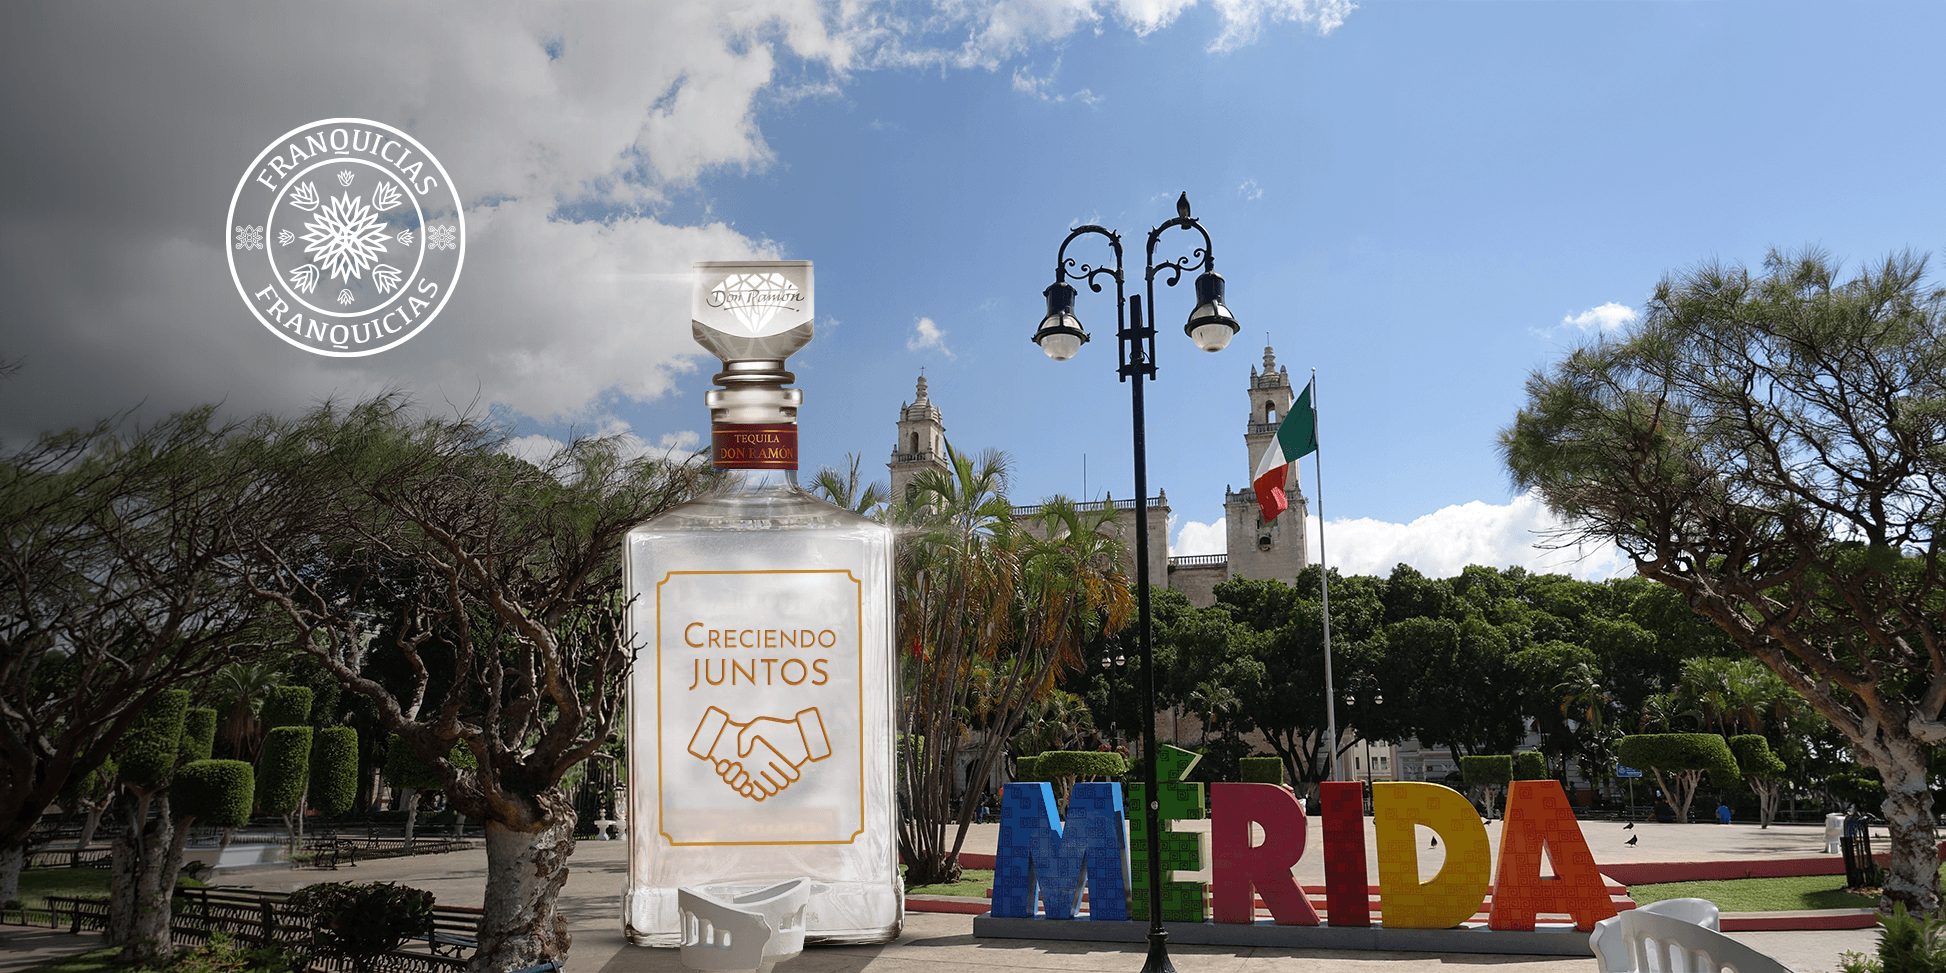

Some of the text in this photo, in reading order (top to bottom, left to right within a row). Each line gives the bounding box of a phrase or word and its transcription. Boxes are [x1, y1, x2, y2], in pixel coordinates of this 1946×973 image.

[706, 284, 805, 310] Don Ramón
[720, 444, 793, 459] DON RAMÓN
[734, 434, 780, 445] TEQUILA
[684, 622, 837, 649] CRECIENDO
[688, 658, 830, 691] JUNTOS
[991, 744, 1618, 932] MÉRIDA
